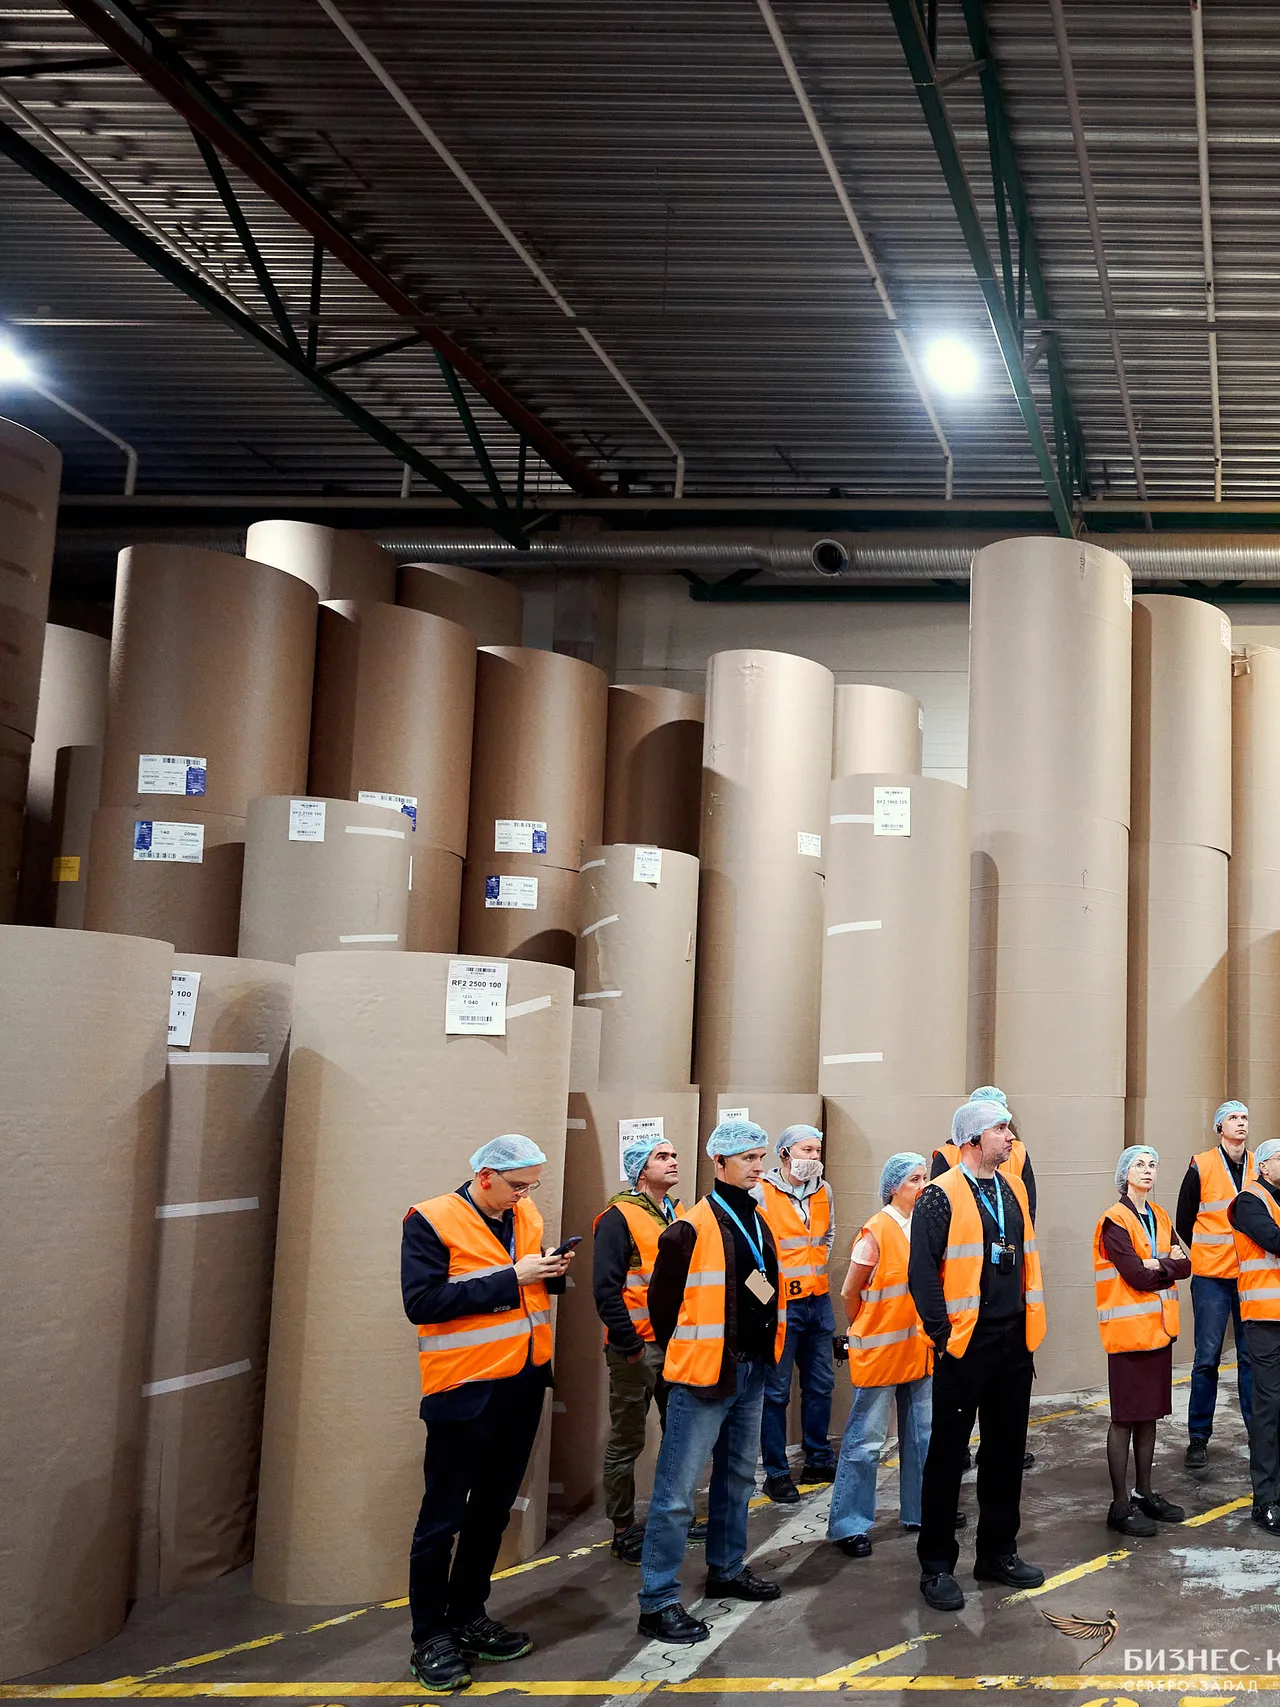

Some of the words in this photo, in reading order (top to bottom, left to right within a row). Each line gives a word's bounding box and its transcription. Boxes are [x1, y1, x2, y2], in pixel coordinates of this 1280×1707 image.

[451, 979, 467, 987] RF2
[469, 980, 487, 988] 2500
[176, 990, 192, 998] 100
